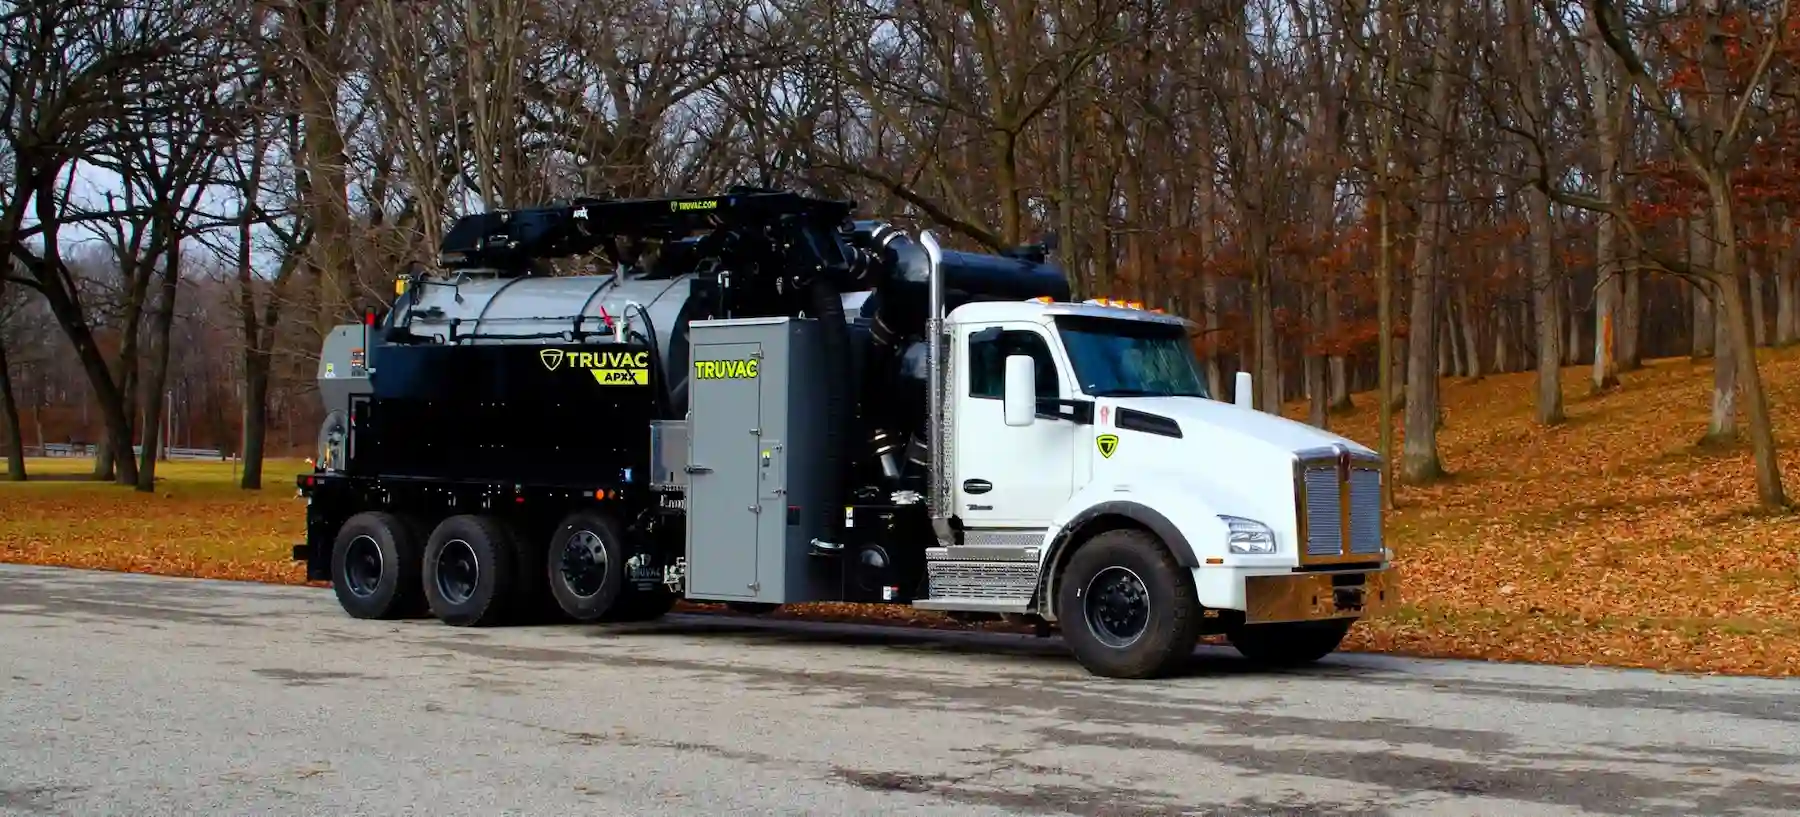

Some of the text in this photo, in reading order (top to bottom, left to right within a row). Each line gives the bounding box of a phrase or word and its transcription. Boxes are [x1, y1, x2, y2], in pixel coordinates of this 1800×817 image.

[566, 351, 649, 368] TRUVAC
[604, 372, 637, 383] APXX
[694, 359, 759, 379] TRUVAC
